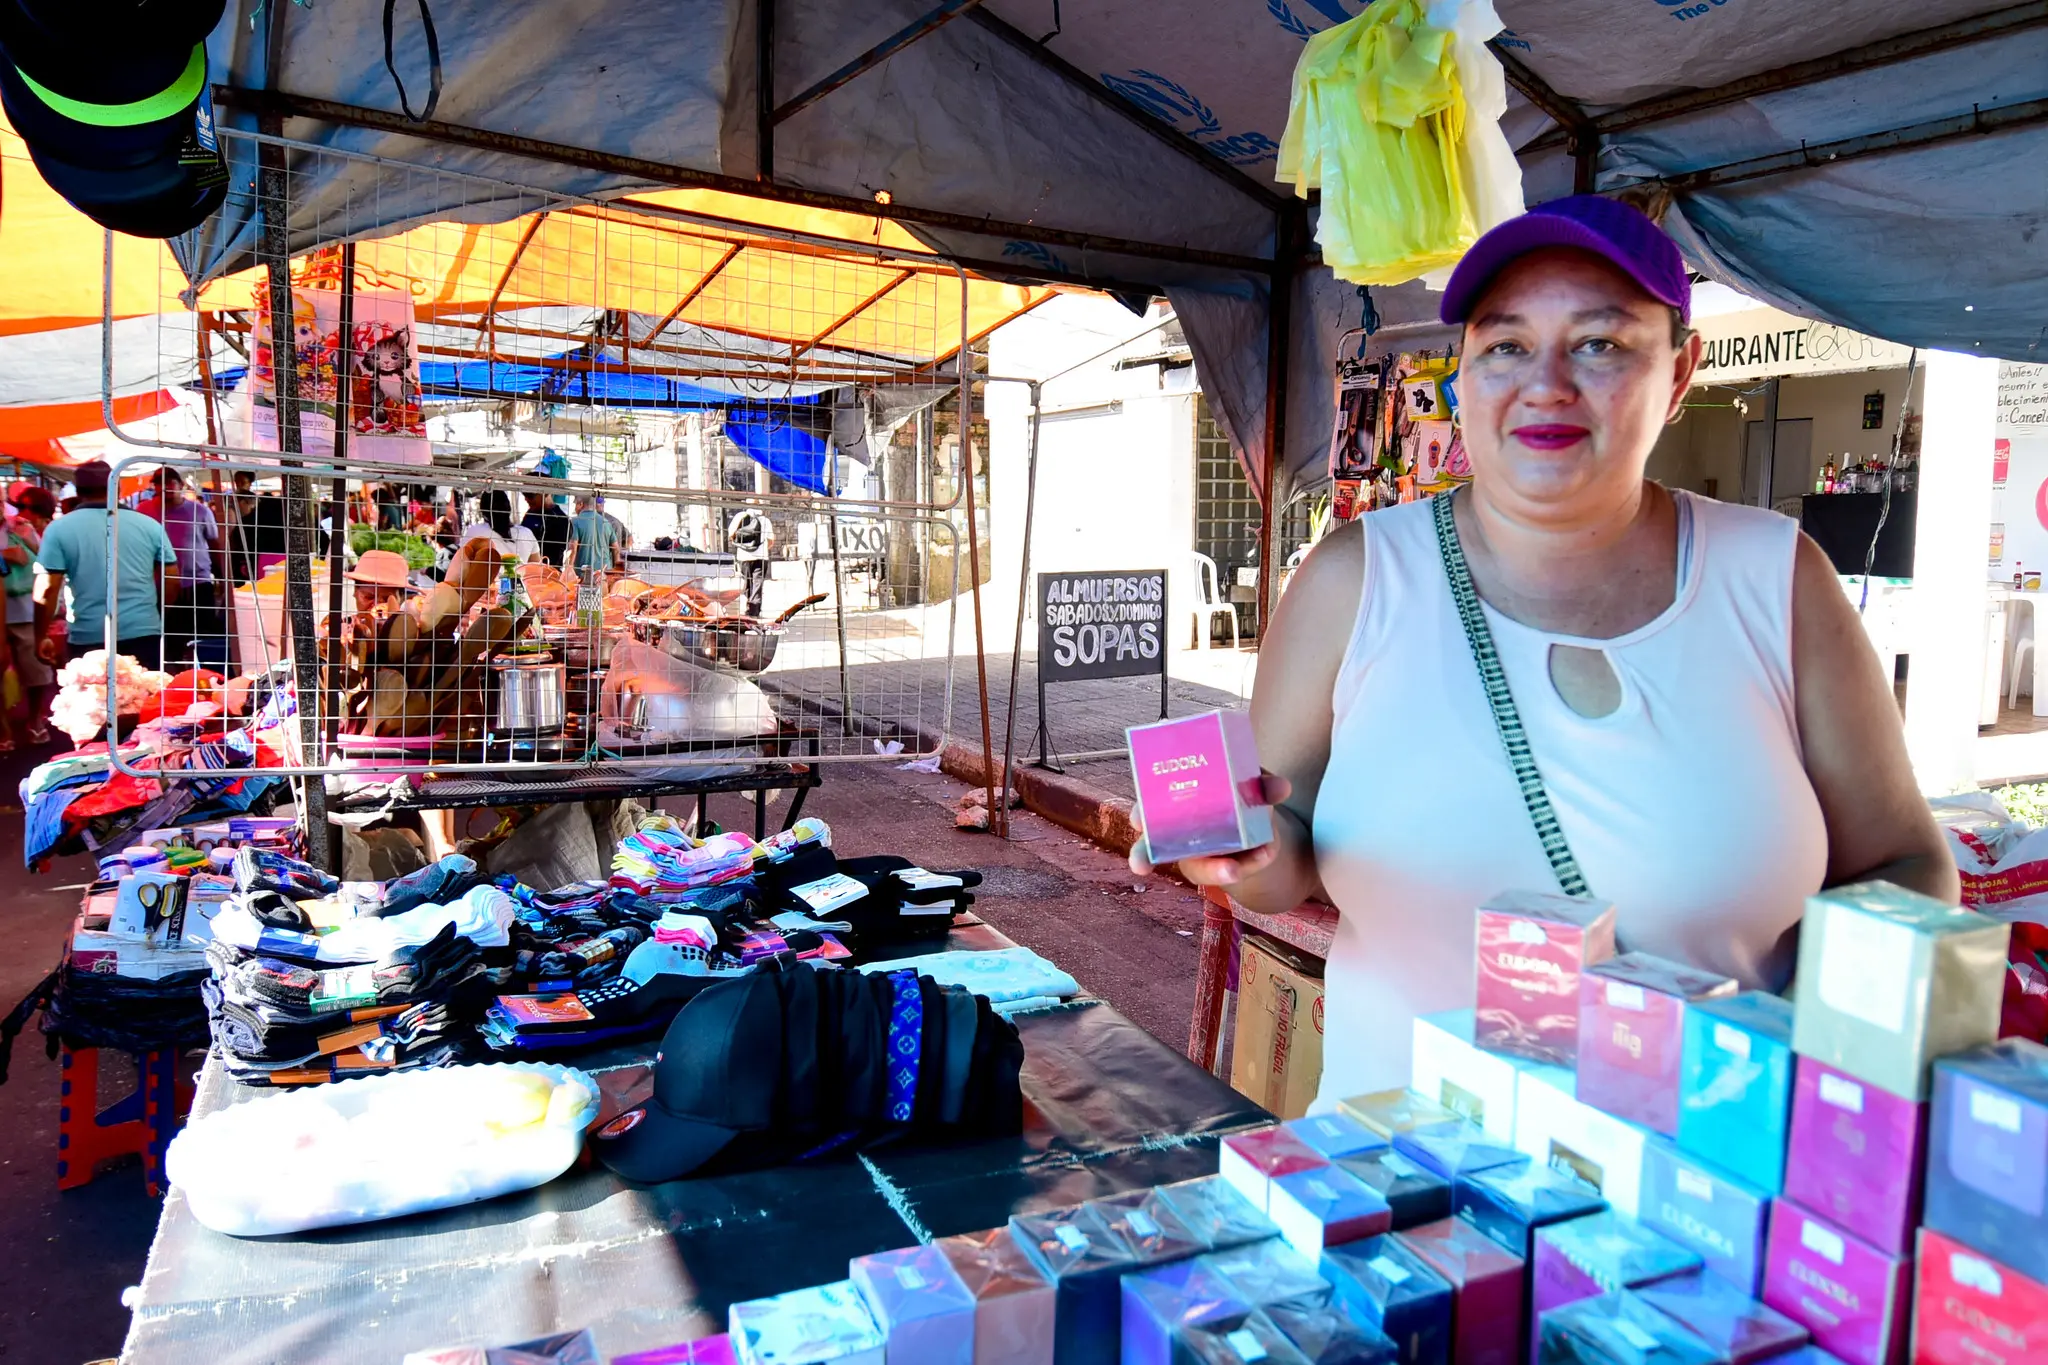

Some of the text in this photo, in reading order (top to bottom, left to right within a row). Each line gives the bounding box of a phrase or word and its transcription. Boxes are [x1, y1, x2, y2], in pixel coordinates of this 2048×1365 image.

[1670, 3, 1710, 21] The
[1203, 131, 1280, 159] HCR
[1703, 328, 1808, 370] AURANTE
[1998, 380, 2036, 392] nsumir
[838, 526, 884, 552] IXO
[1047, 576, 1162, 603] ALMUERSOS
[1053, 622, 1160, 667] SOPAS
[1152, 753, 1208, 775] EUDORA
